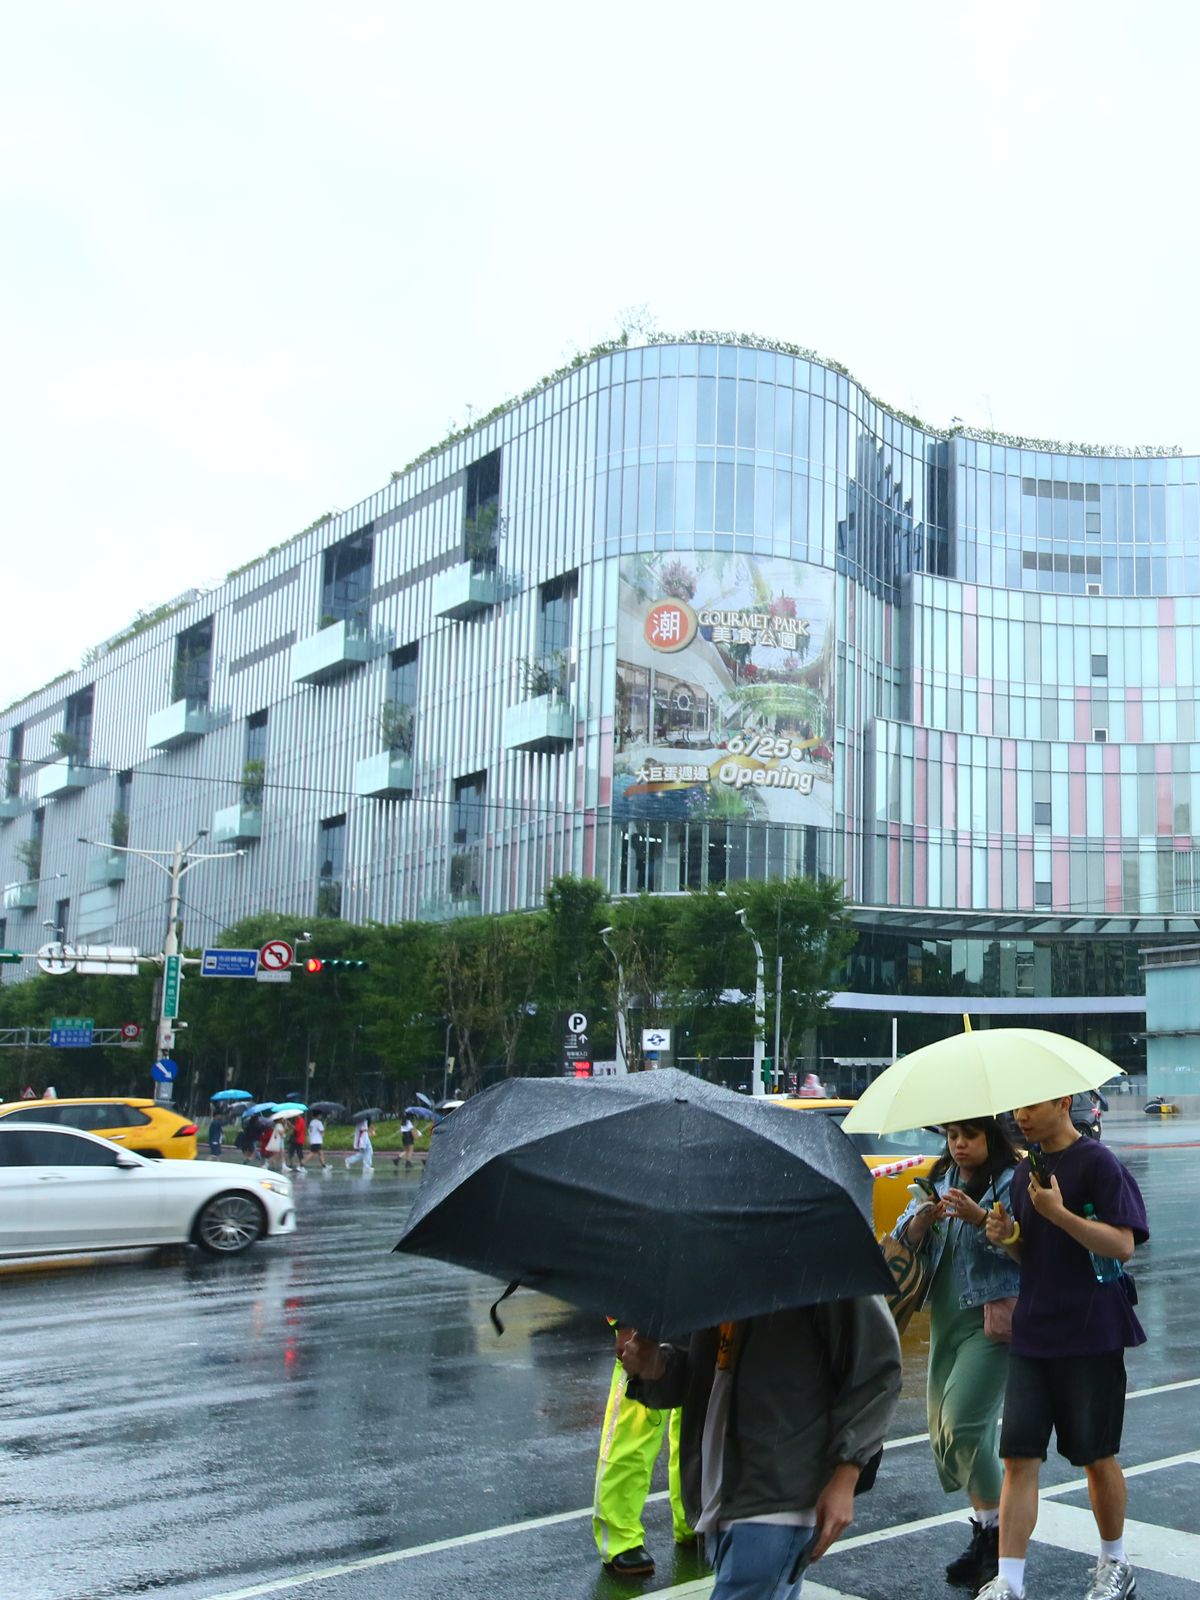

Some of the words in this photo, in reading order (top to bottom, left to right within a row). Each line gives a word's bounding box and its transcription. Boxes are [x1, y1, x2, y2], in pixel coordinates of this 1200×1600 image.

[652, 610, 681, 641] 潮
[698, 609, 770, 630] GOURMET
[773, 615, 810, 636] PARK
[711, 626, 797, 650] 美食公園
[719, 762, 813, 794] Opening
[573, 1016, 583, 1030] P
